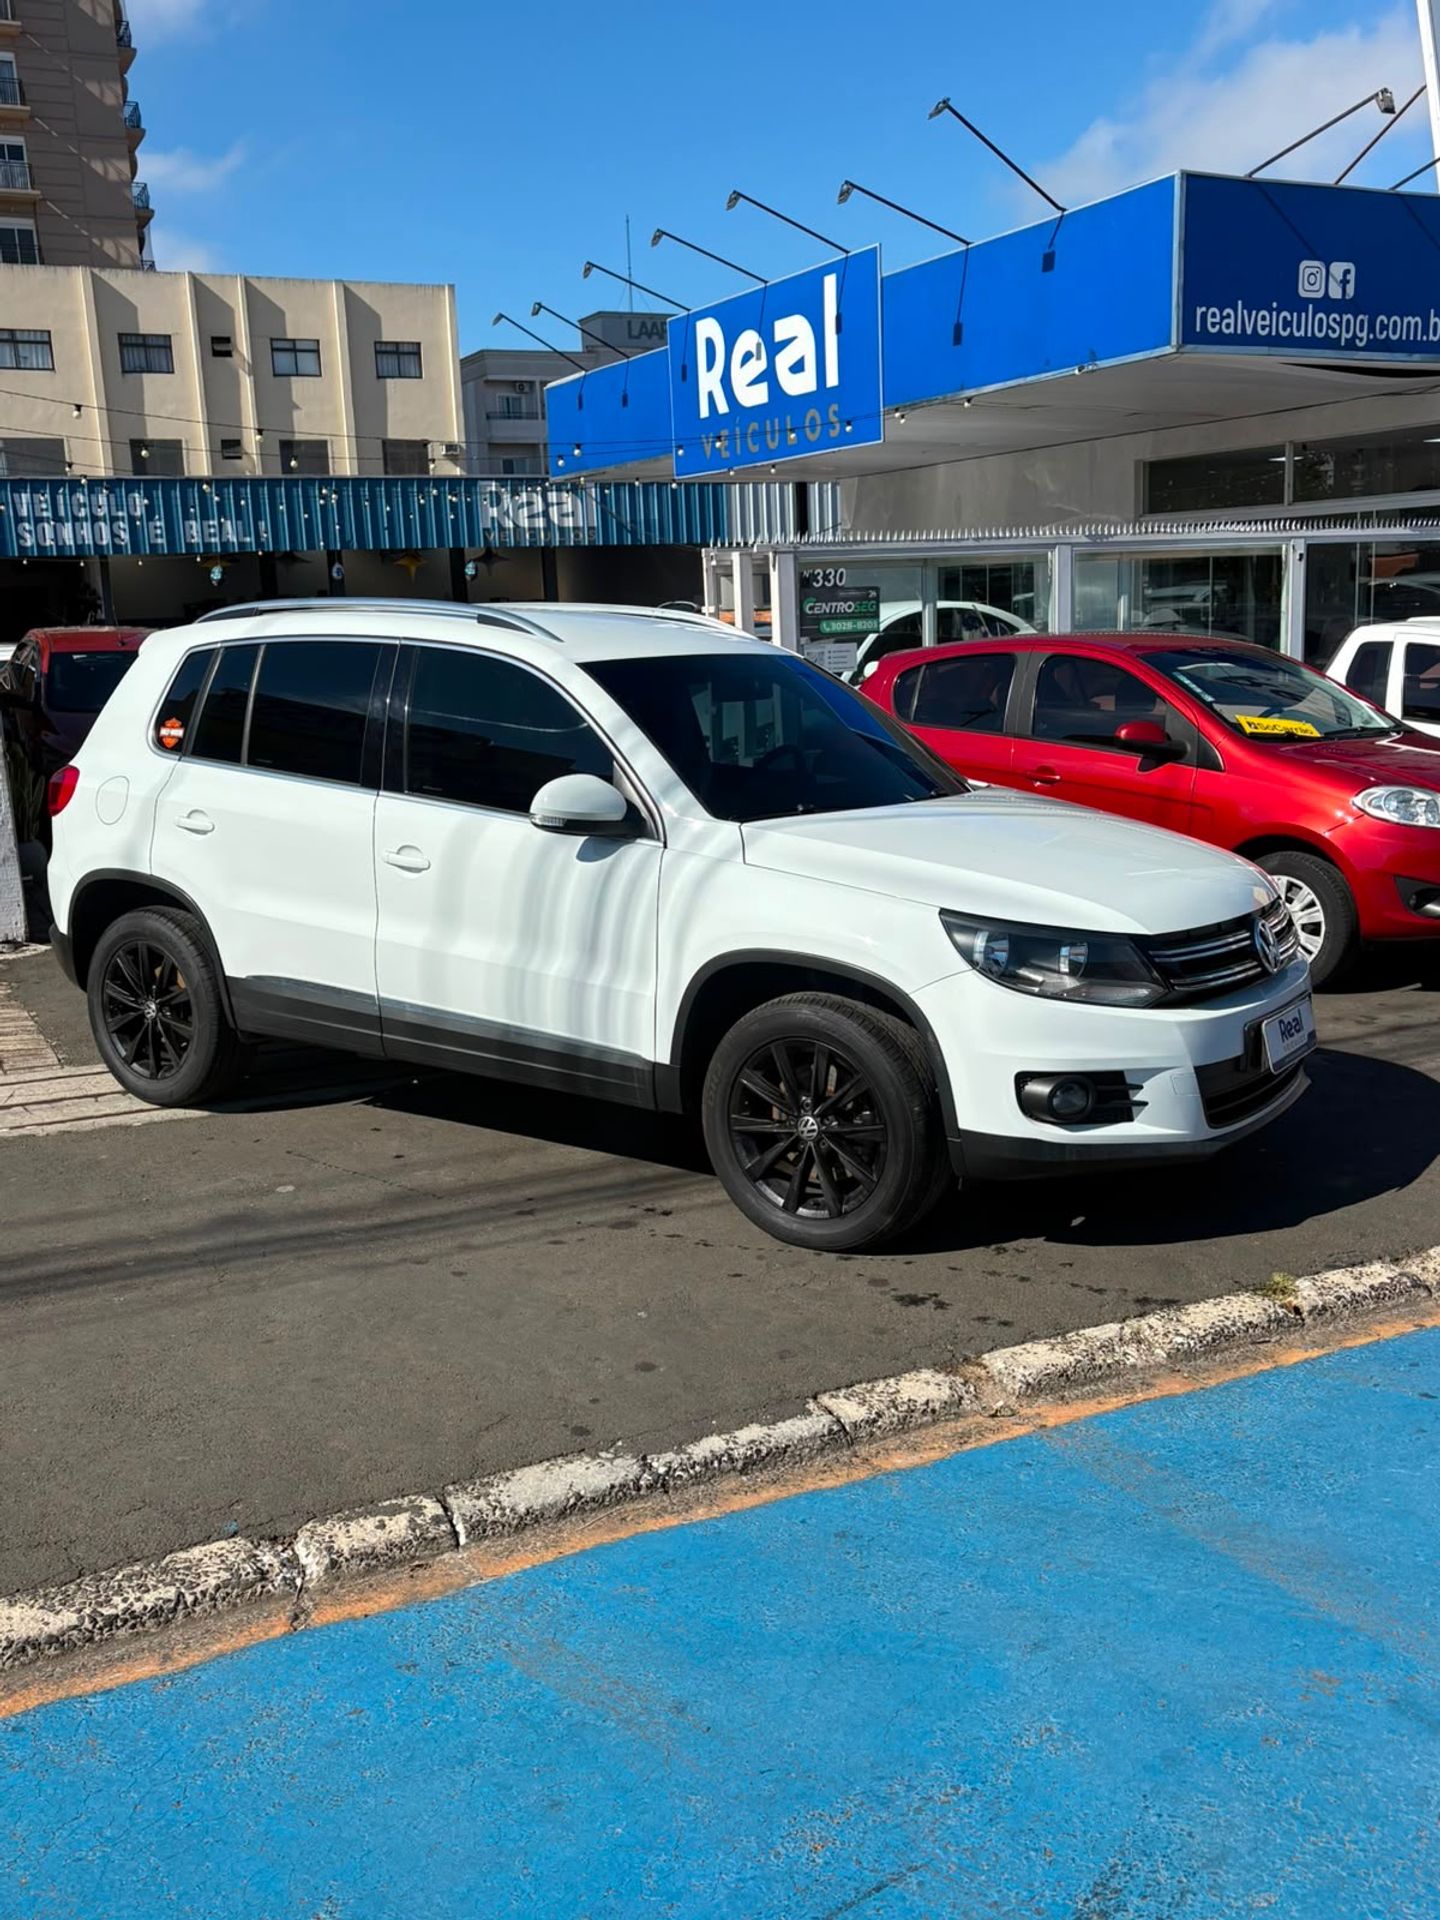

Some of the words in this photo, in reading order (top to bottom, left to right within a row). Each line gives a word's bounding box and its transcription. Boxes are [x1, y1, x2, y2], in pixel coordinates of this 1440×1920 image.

[695, 272, 839, 419] Real
[478, 480, 597, 527] Real
[17, 521, 129, 547] SONHOS
[812, 568, 847, 587] 330
[804, 598, 877, 614] CENTROSEG
[1278, 1008, 1304, 1043] Real
